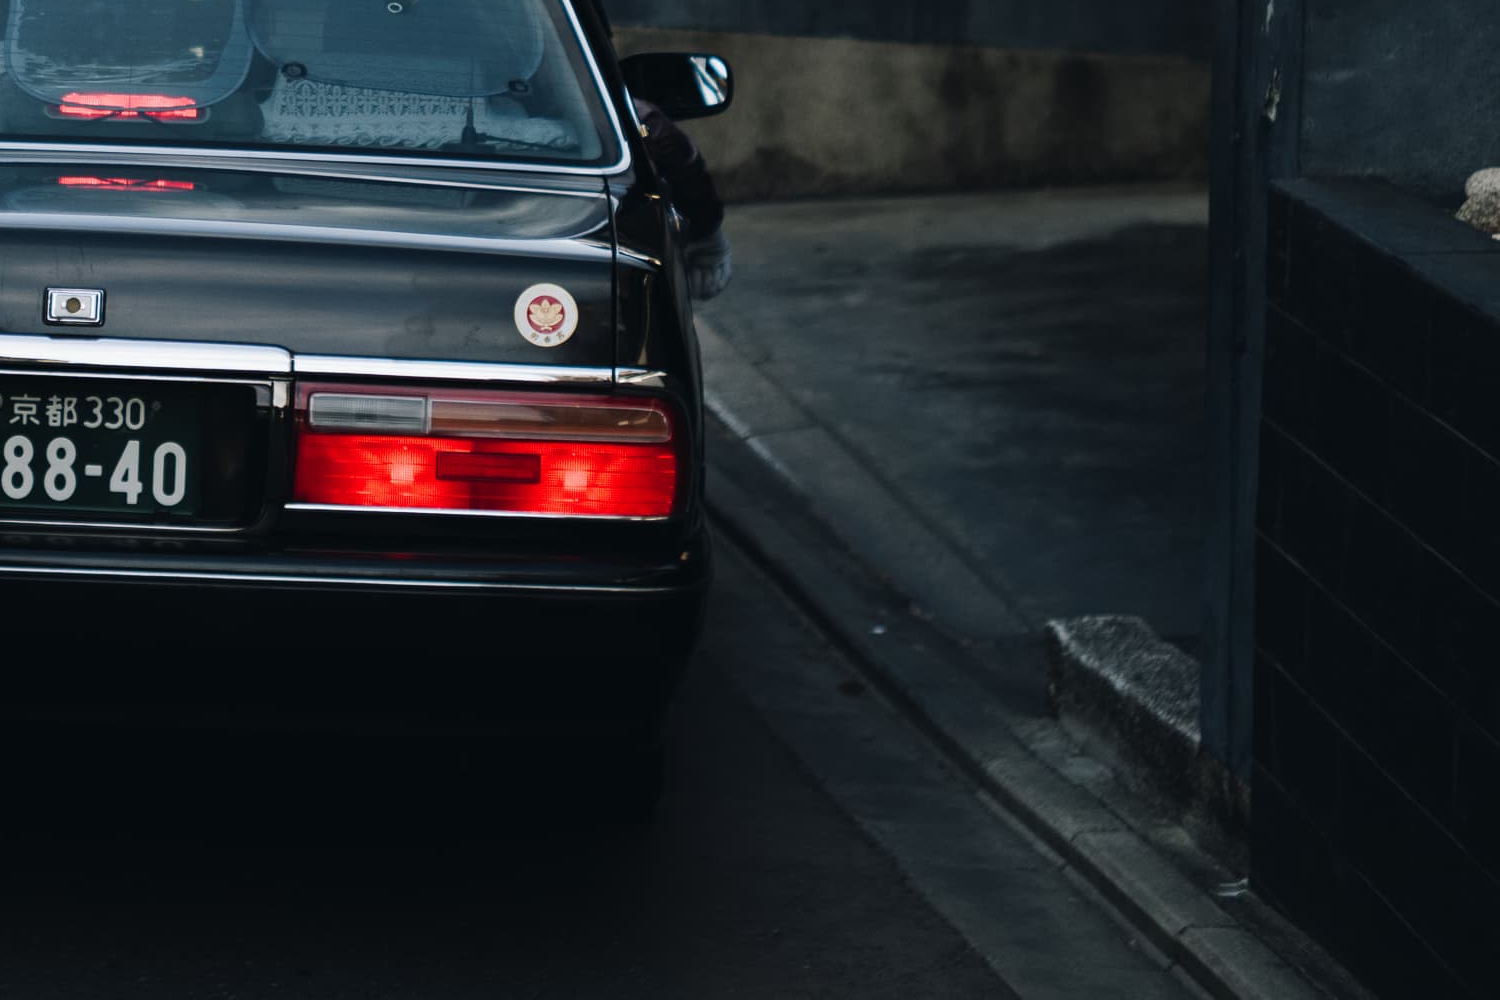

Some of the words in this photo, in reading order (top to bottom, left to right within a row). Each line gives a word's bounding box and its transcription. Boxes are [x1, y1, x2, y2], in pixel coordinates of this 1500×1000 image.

[9, 394, 78, 427] 京都
[83, 396, 145, 430] 330
[0, 434, 187, 507] 88-40
